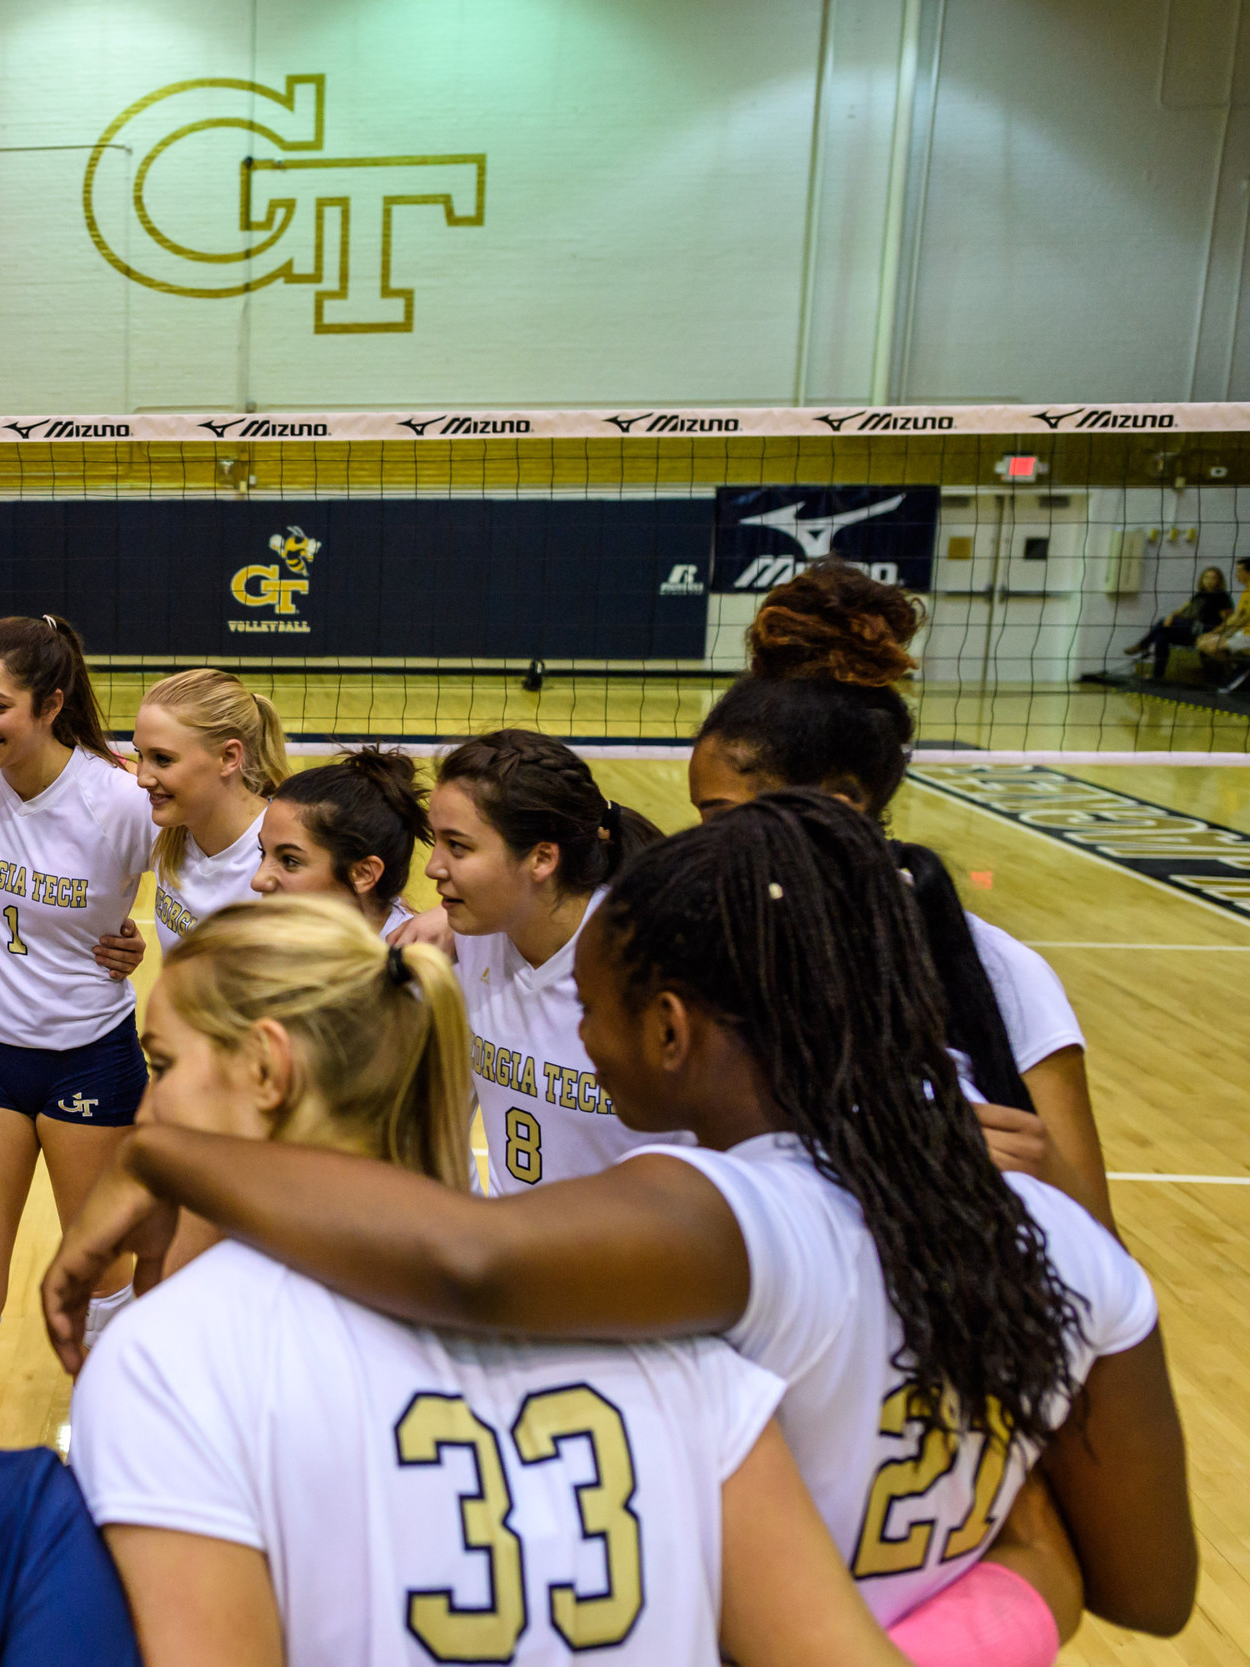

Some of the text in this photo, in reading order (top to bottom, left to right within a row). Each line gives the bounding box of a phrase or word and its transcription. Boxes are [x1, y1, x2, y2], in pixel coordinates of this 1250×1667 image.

[31, 870, 89, 908] TECH
[3, 905, 28, 955] 1
[470, 1034, 537, 1098] ORGIA
[506, 1106, 542, 1185] 8
[849, 1377, 1013, 1581] 21
[393, 1381, 645, 1665] 33
